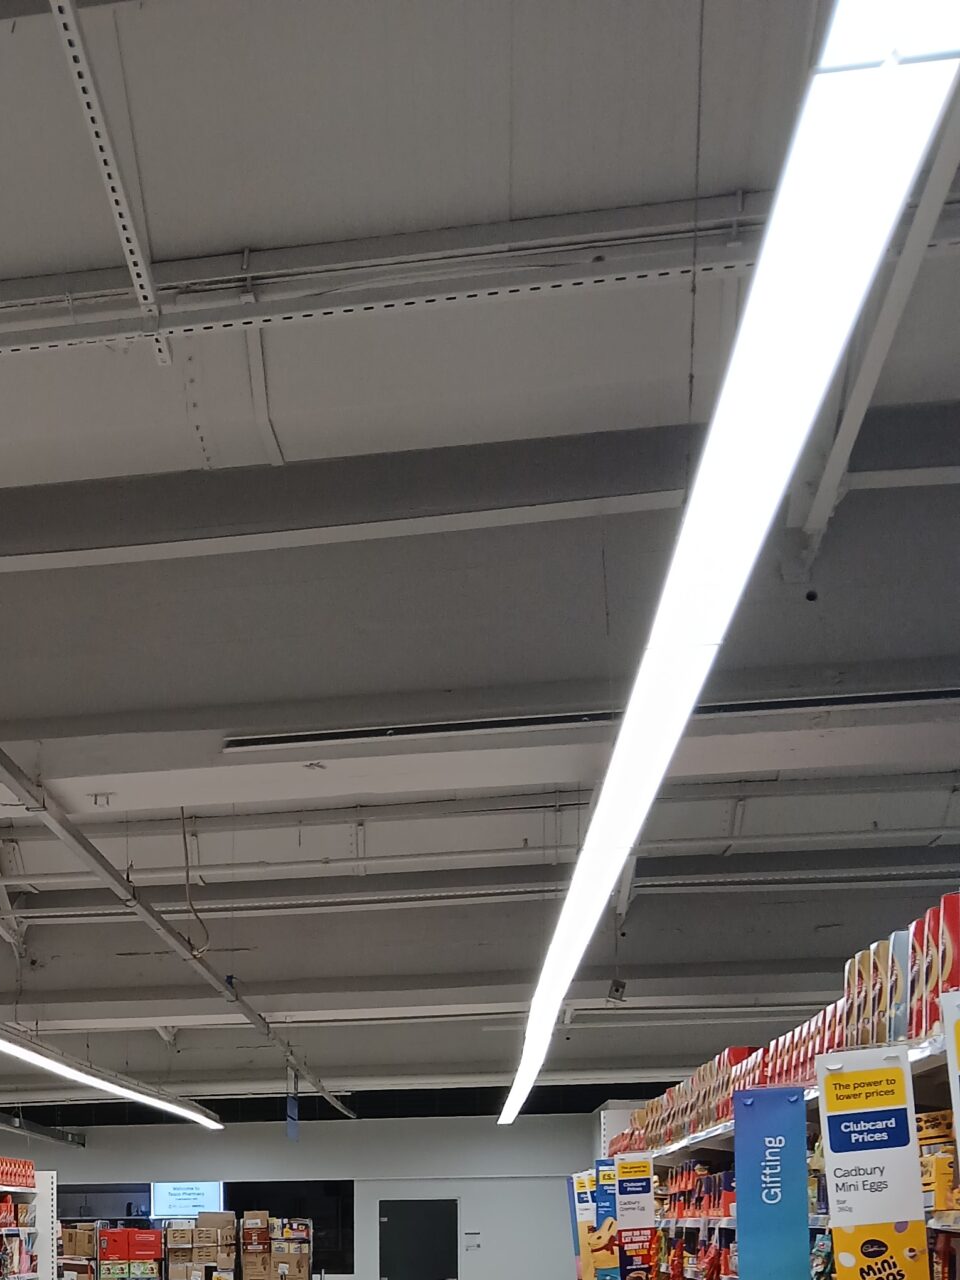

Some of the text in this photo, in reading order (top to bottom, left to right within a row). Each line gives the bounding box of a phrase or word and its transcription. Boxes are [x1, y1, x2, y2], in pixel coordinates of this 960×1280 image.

[832, 1078, 896, 1092] The power to
[835, 1088, 895, 1101] lower prices
[840, 1117, 896, 1133] Clubcard
[850, 1131, 889, 1143] Prices
[761, 1135, 786, 1204] Gifting
[833, 1165, 885, 1179] Cadbury
[835, 1179, 889, 1193] Mini Eggs
[859, 1255, 898, 1280] Mini
